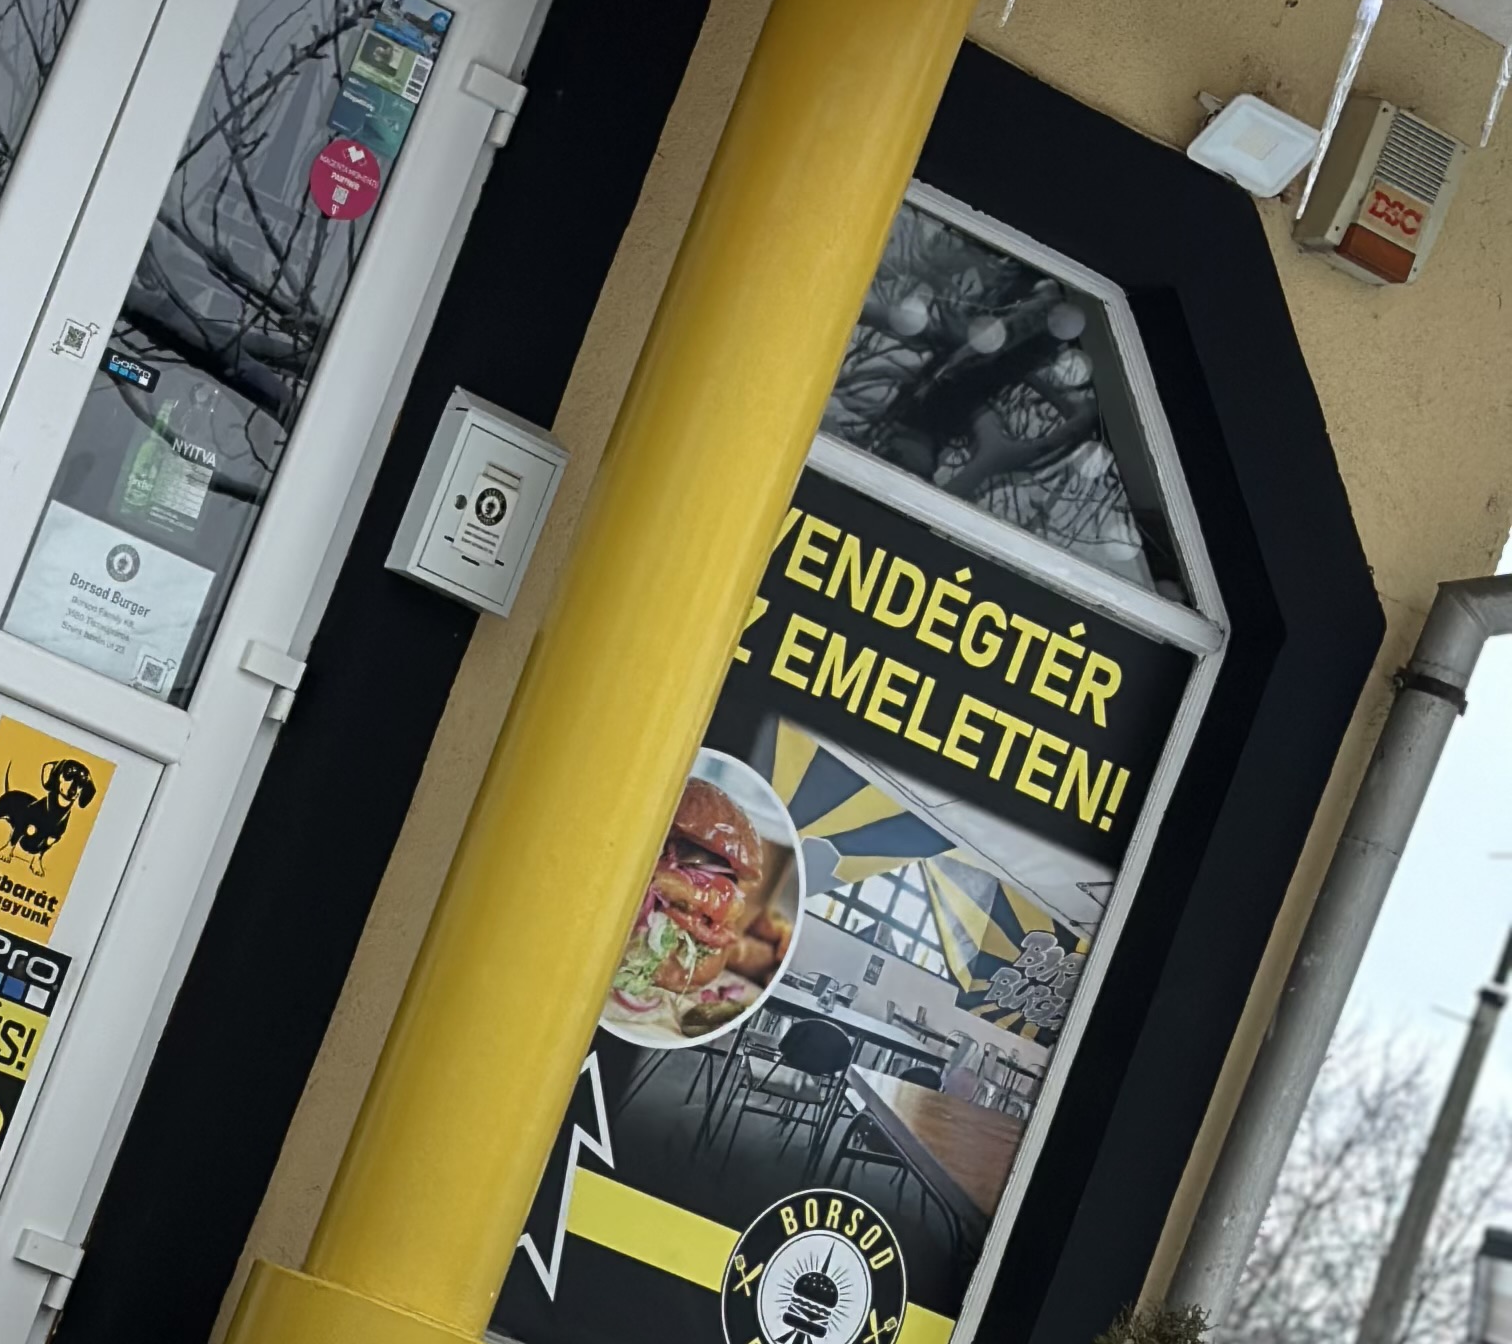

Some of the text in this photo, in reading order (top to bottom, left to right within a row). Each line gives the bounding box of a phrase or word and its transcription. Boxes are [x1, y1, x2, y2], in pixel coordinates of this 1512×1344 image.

[111, 354, 151, 380] GoPro
[170, 437, 218, 469] NYITVA
[69, 572, 112, 600] Borsod
[111, 590, 152, 618] Burger
[770, 612, 1131, 833] EMELETEN!
[779, 1197, 895, 1271] BORSOD
